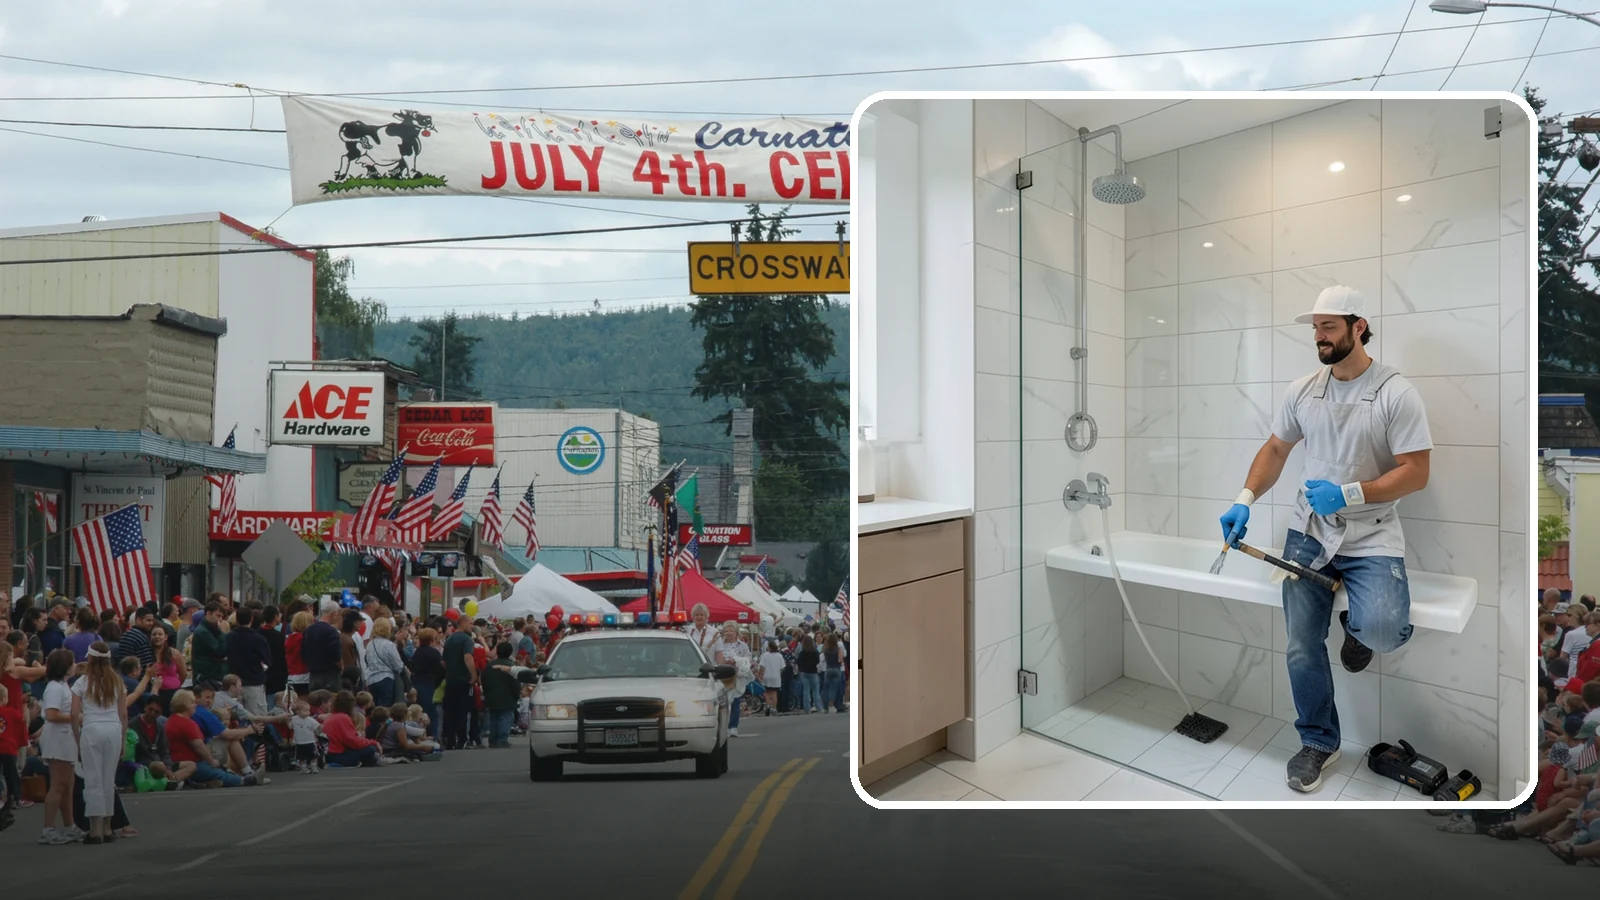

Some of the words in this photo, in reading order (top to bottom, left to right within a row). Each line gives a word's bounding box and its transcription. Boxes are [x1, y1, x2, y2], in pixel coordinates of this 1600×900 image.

[695, 121, 850, 150] Carnat
[481, 140, 605, 193] JULY
[632, 150, 747, 198] 4th.
[697, 254, 850, 280] CROSSWA
[283, 380, 374, 420] ACE
[405, 409, 453, 422] CEDAR
[283, 421, 371, 437] Hardware
[416, 427, 478, 447] Coca-Cola
[95, 485, 124, 495] Vincent
[126, 485, 136, 495] de
[137, 486, 155, 495] Paul
[688, 526, 741, 535] CRNATION
[699, 535, 730, 543] GLASS
